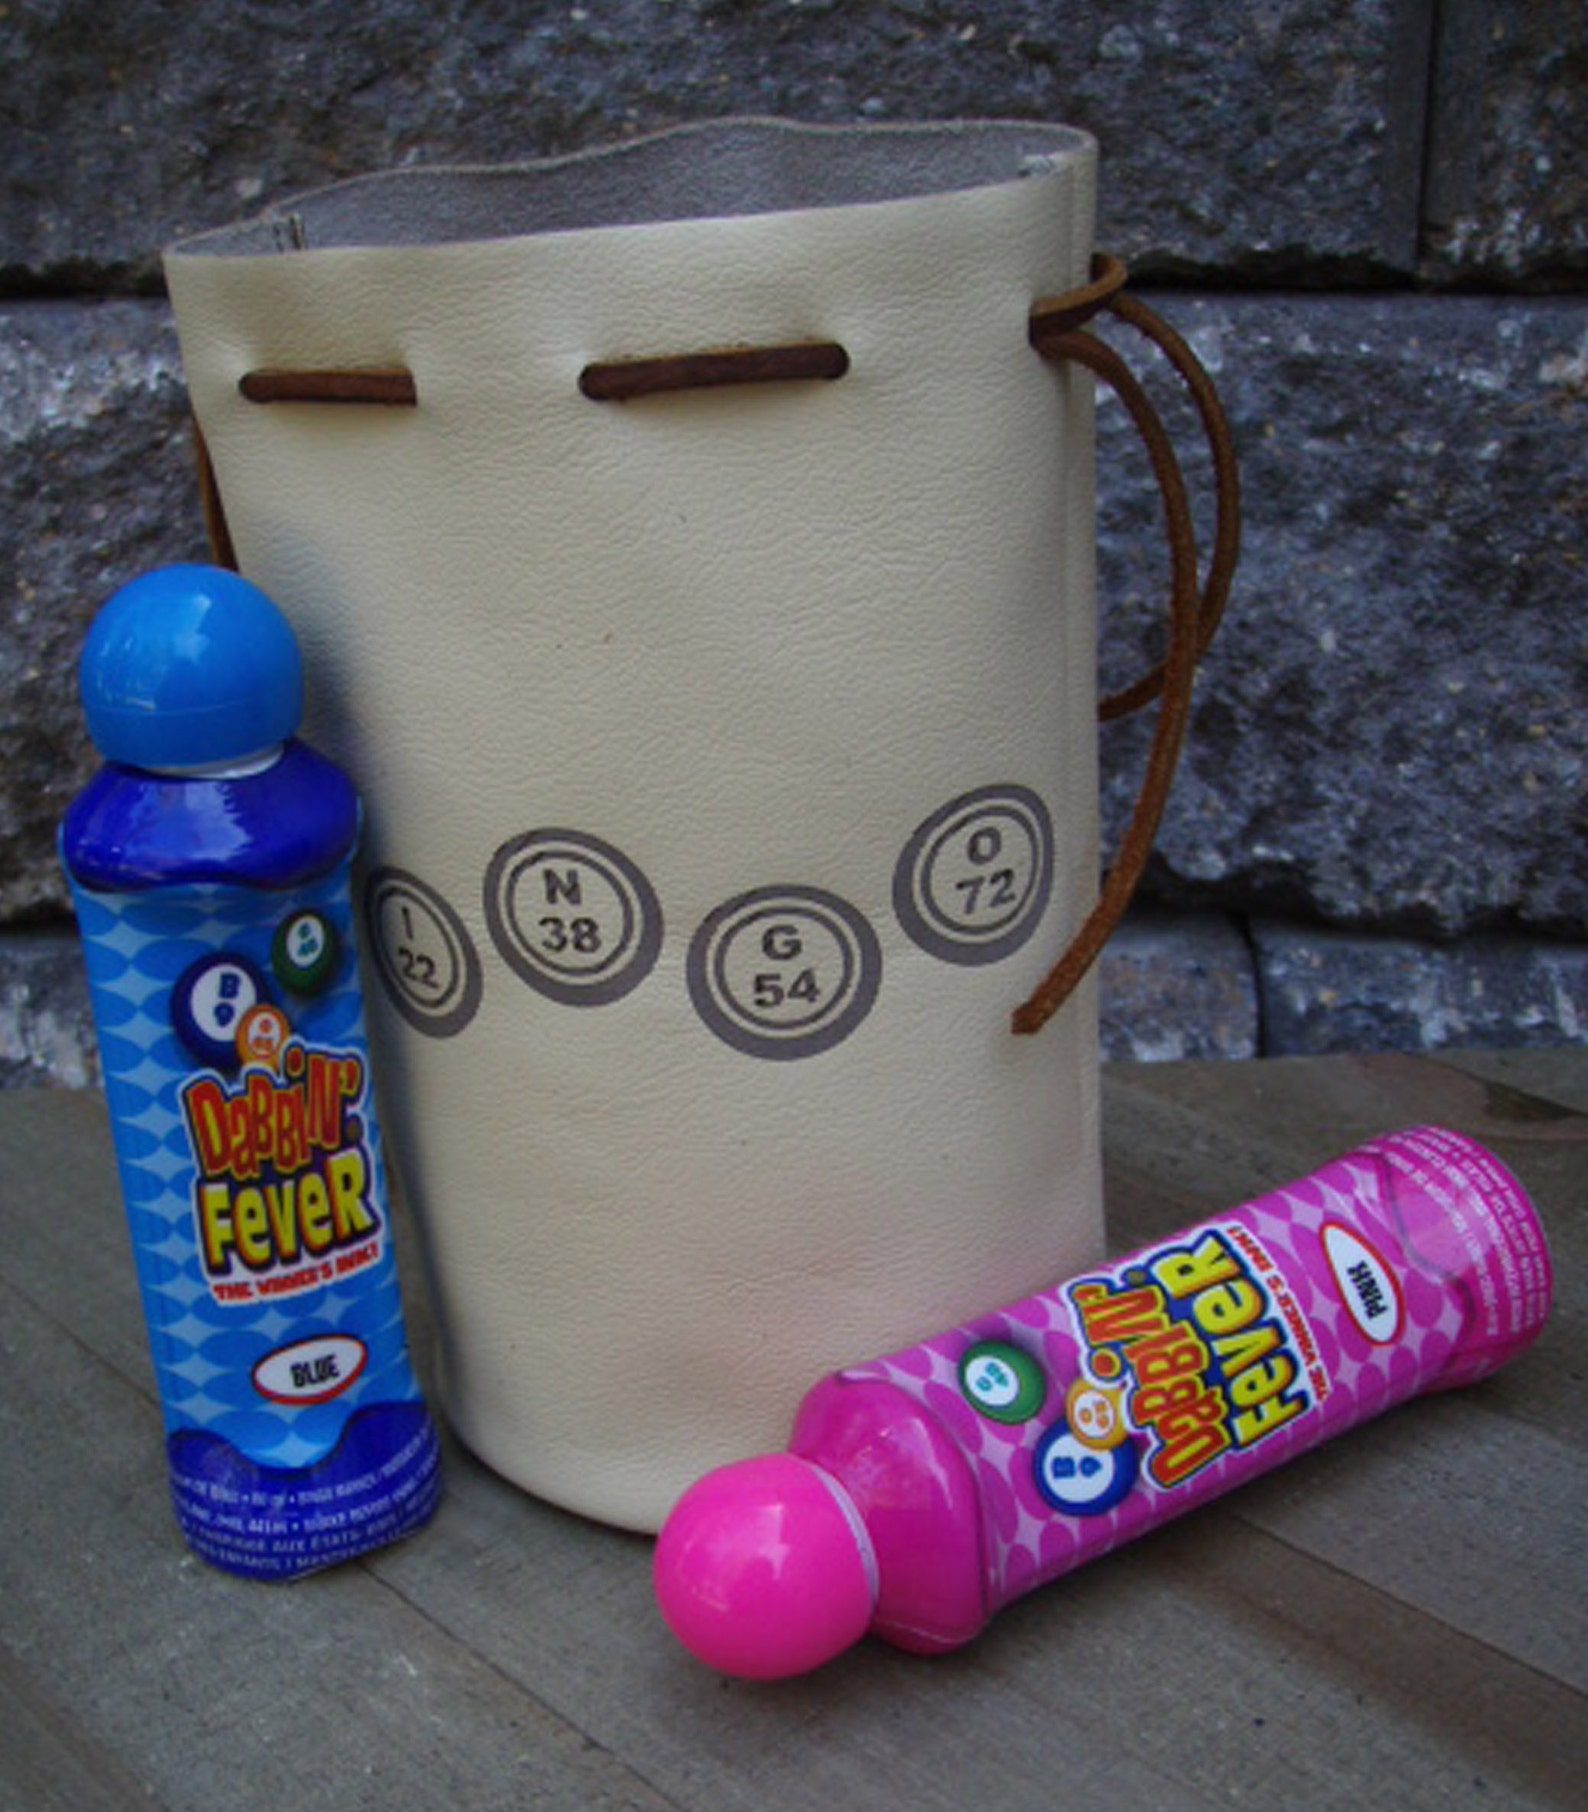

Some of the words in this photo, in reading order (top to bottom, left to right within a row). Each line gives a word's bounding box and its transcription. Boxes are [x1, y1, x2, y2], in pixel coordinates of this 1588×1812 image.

[967, 827, 1002, 865] O
[543, 869, 582, 905] N
[956, 869, 1016, 915] 72
[539, 917, 601, 953] 38
[762, 925, 802, 960] G
[219, 972, 240, 999] B
[398, 947, 440, 990] 22
[754, 967, 820, 1007] 54
[212, 1283, 254, 1300] THE
[1346, 1260, 1388, 1320] PINK
[289, 1353, 341, 1389] BLUE
[1051, 1456, 1077, 1479] B
